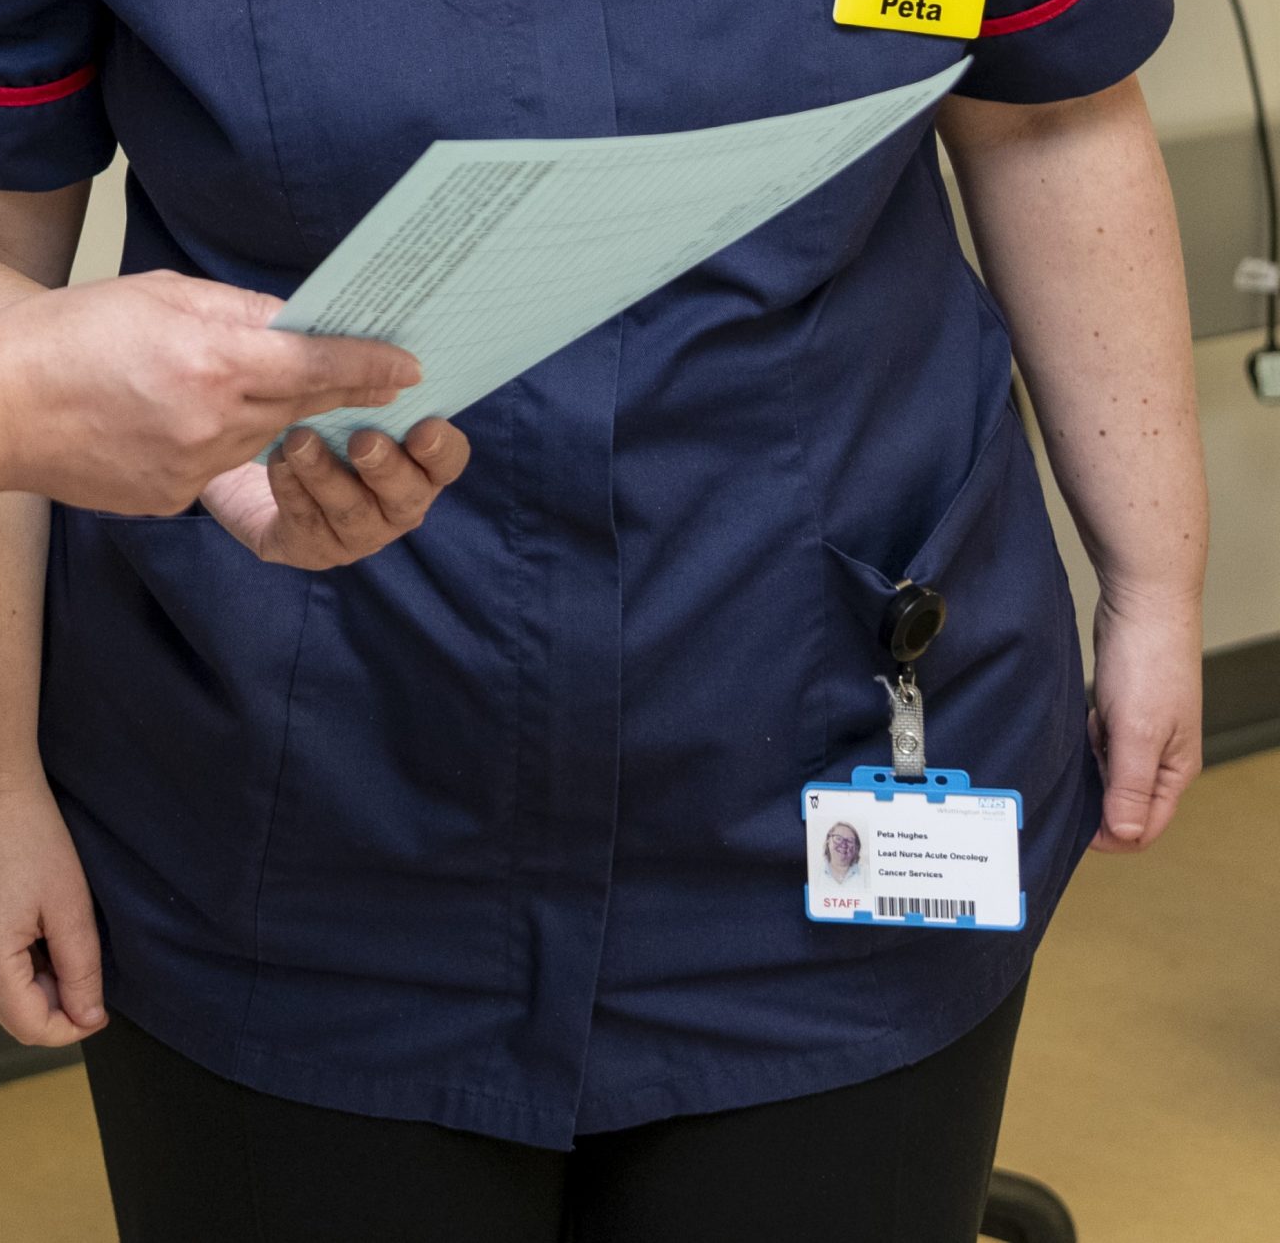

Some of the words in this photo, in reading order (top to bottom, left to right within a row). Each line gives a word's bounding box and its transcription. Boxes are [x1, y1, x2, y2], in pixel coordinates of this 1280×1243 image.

[978, 798, 1006, 808] NHS
[877, 830, 895, 838] Peta
[897, 831, 928, 841] Hughes
[877, 849, 897, 857] Lead
[899, 850, 923, 859] Nurse
[925, 851, 948, 860] Acute
[949, 852, 989, 863] Oncology
[878, 868, 907, 877] Cancer
[908, 869, 943, 879] Services
[824, 897, 861, 909] STAFF
